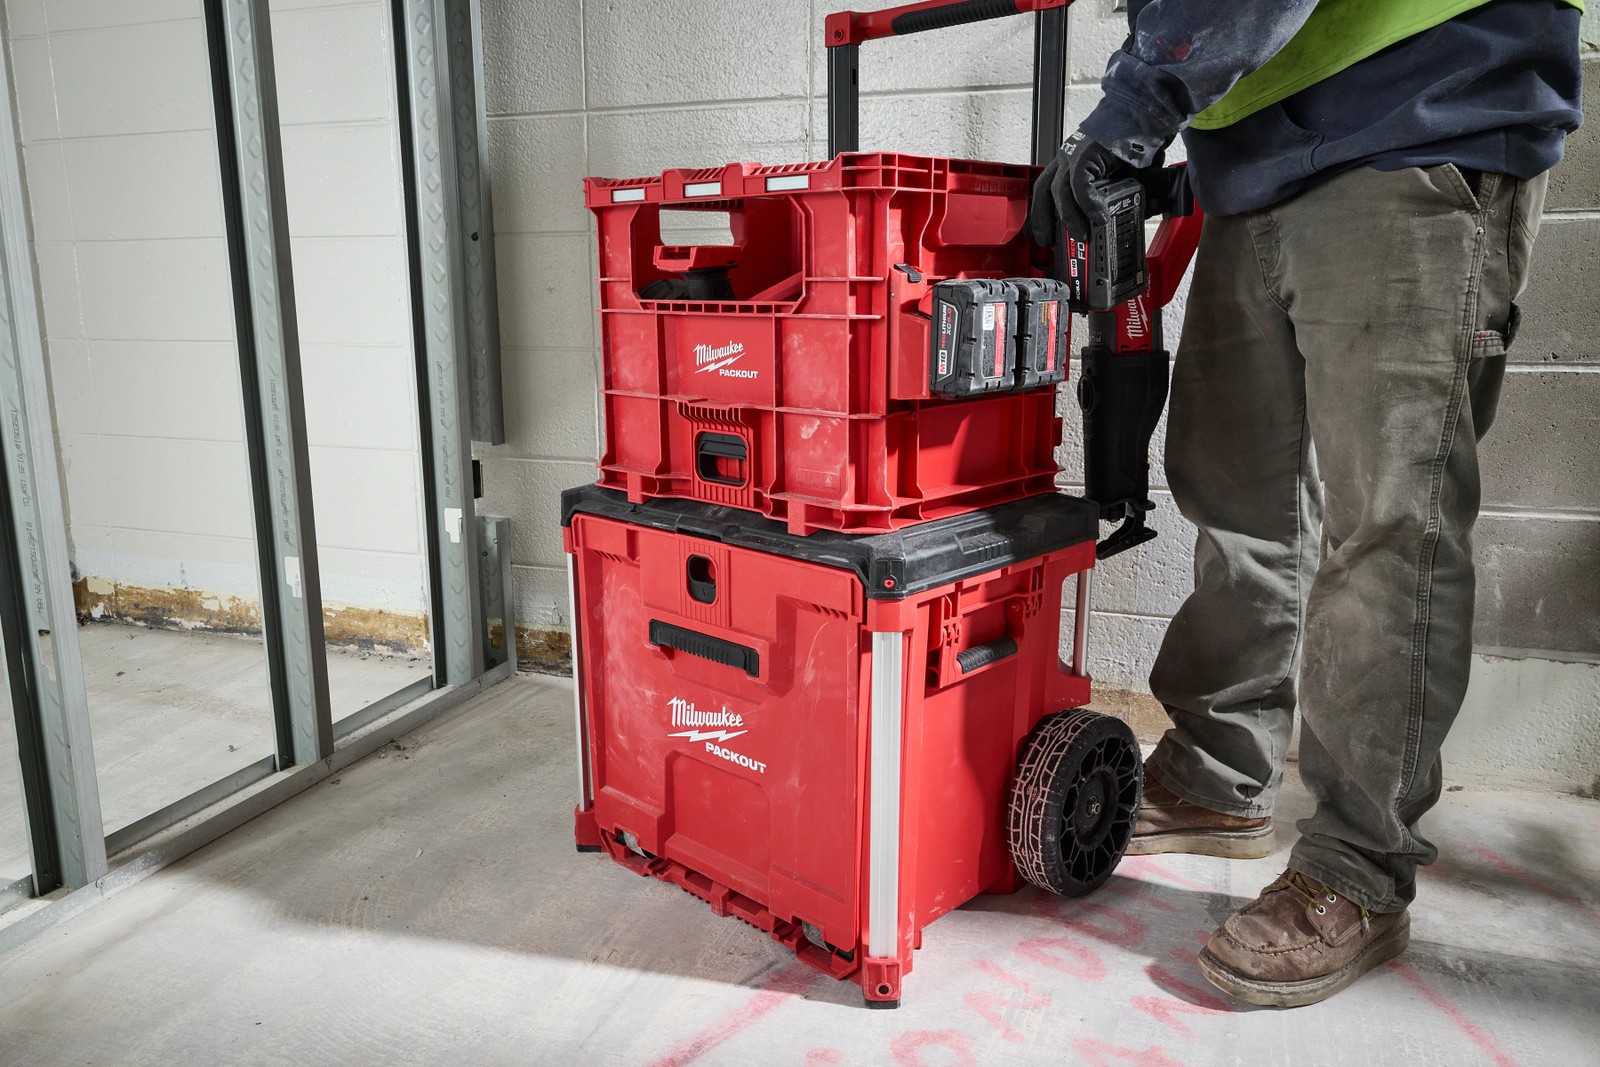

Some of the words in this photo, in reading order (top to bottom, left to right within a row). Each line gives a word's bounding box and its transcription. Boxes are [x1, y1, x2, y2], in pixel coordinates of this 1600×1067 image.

[693, 340, 744, 366] Milwaukee
[939, 351, 947, 374] M18
[719, 368, 758, 379] PACKOUT
[666, 696, 744, 728] Milwaukee
[705, 741, 767, 774] PACKOUT
